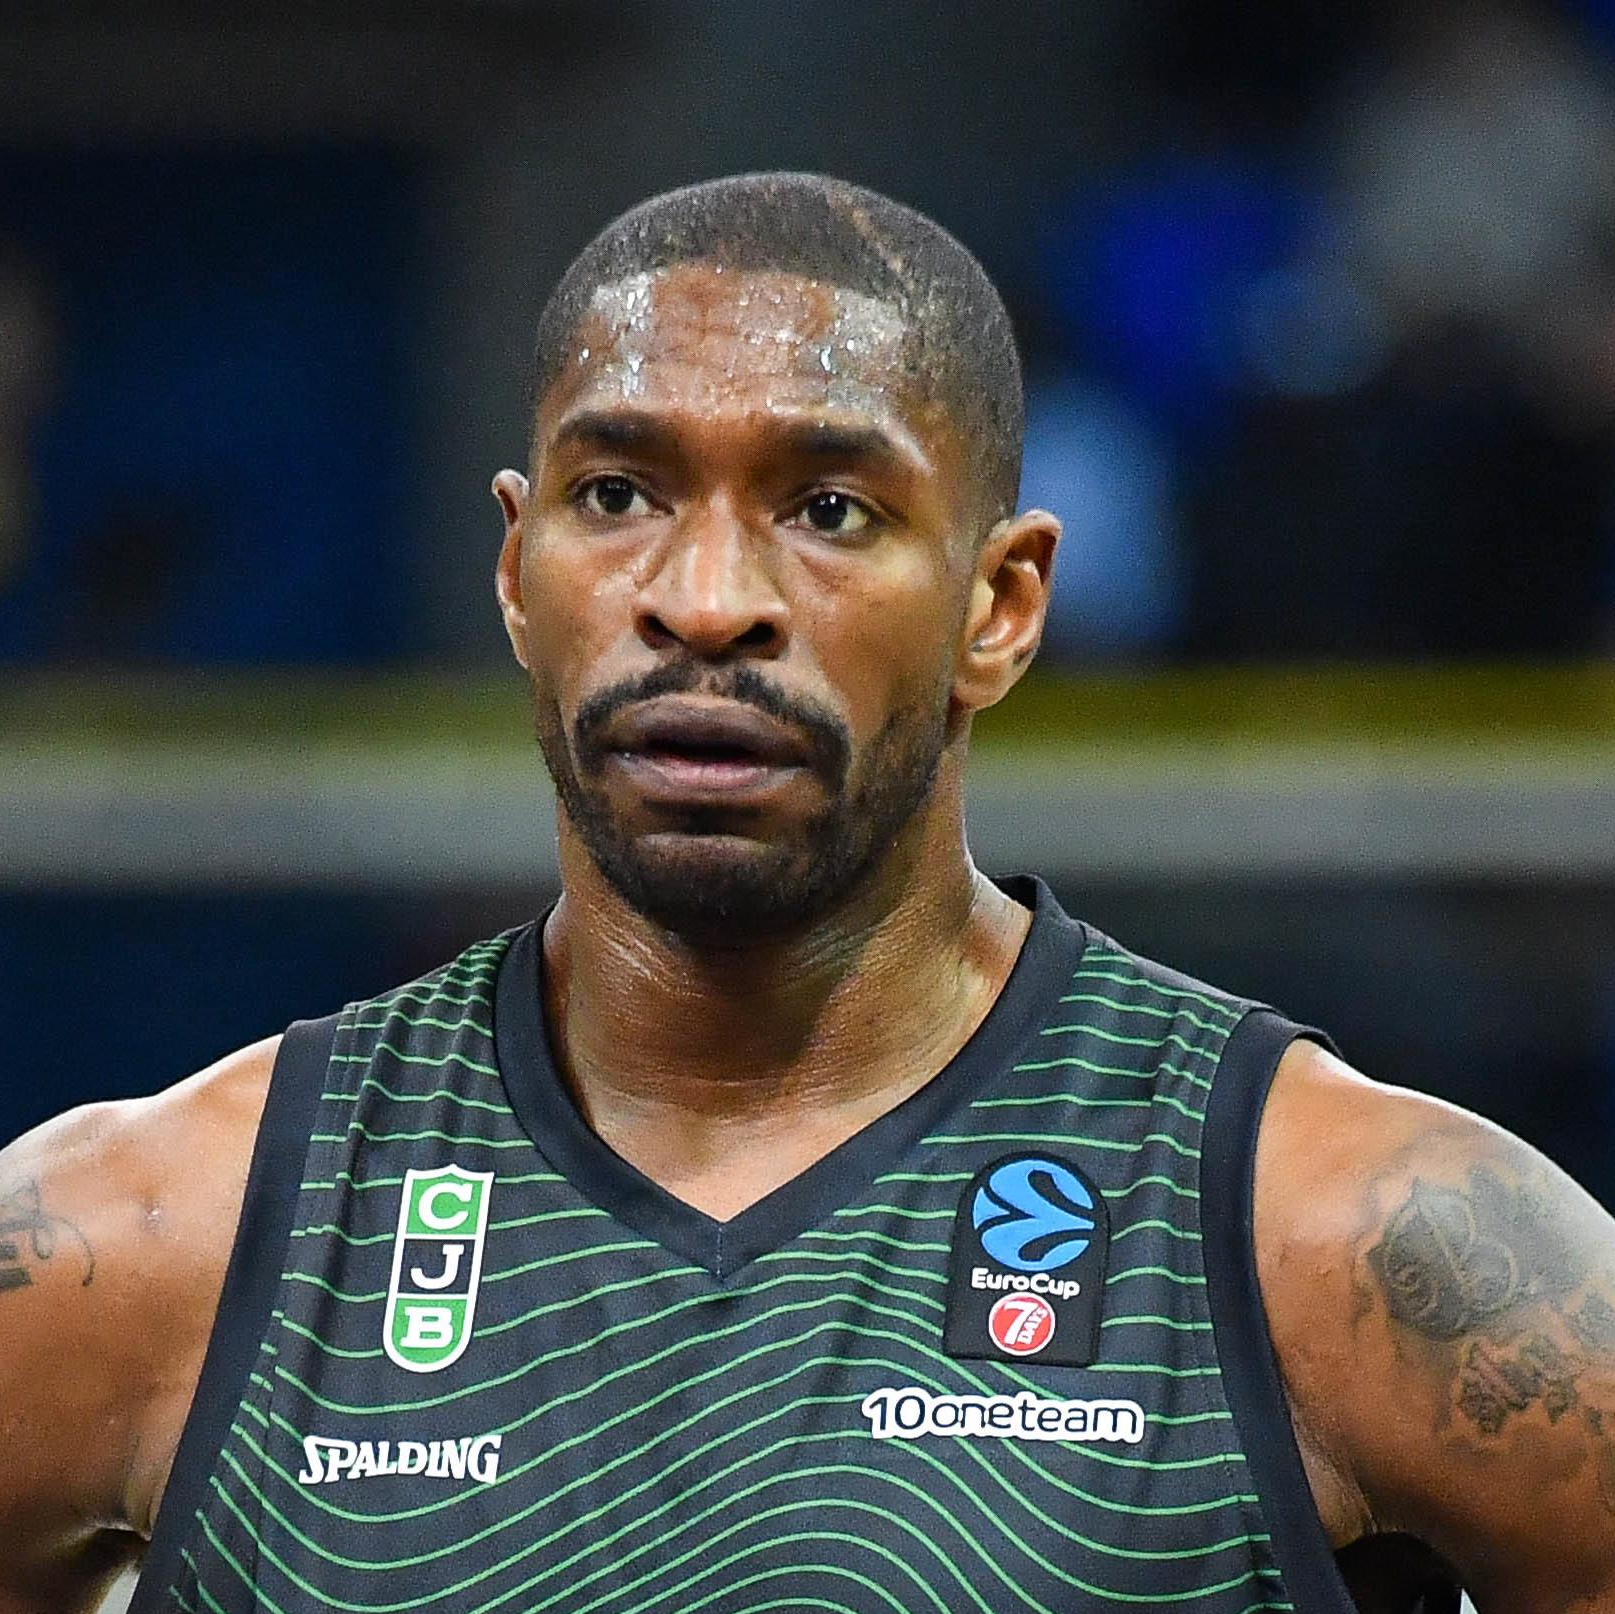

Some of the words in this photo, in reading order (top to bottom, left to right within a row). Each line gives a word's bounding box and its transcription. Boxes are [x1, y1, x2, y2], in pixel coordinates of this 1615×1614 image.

[971, 1267, 1080, 1299] EuroCup
[1002, 1301, 1038, 1345] 7
[1017, 1306, 1048, 1344] DAYS
[299, 1434, 502, 1484] SPALDING
